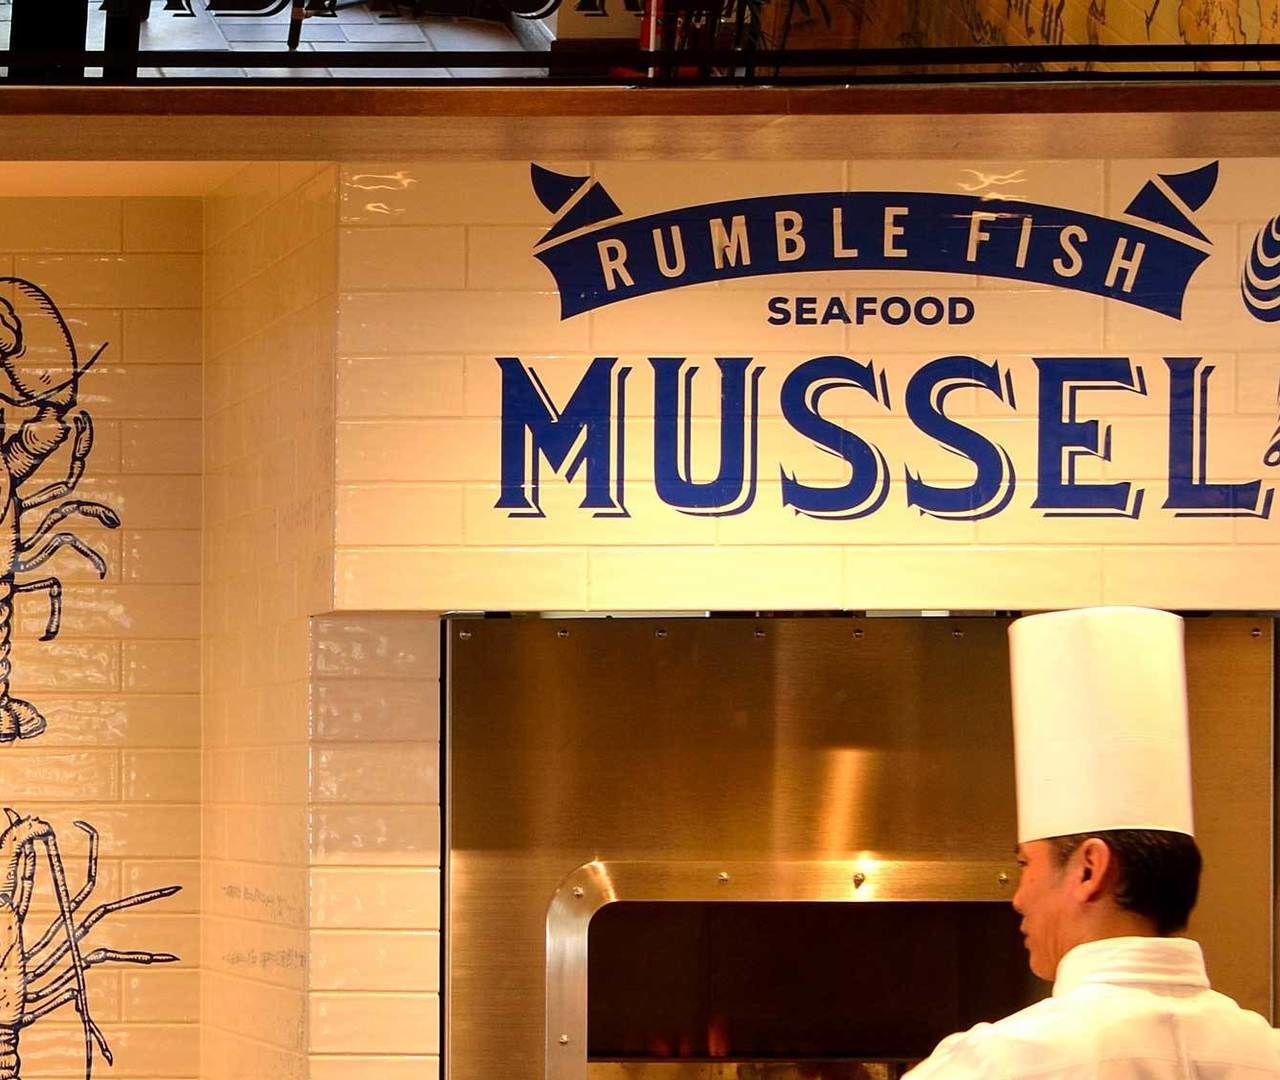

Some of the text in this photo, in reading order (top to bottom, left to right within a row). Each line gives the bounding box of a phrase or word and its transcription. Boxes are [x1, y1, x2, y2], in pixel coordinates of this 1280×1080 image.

[597, 206, 1147, 293] RUMBLE FISH
[768, 296, 975, 326] SEAFOOD
[495, 356, 1273, 520] MUSSEL
